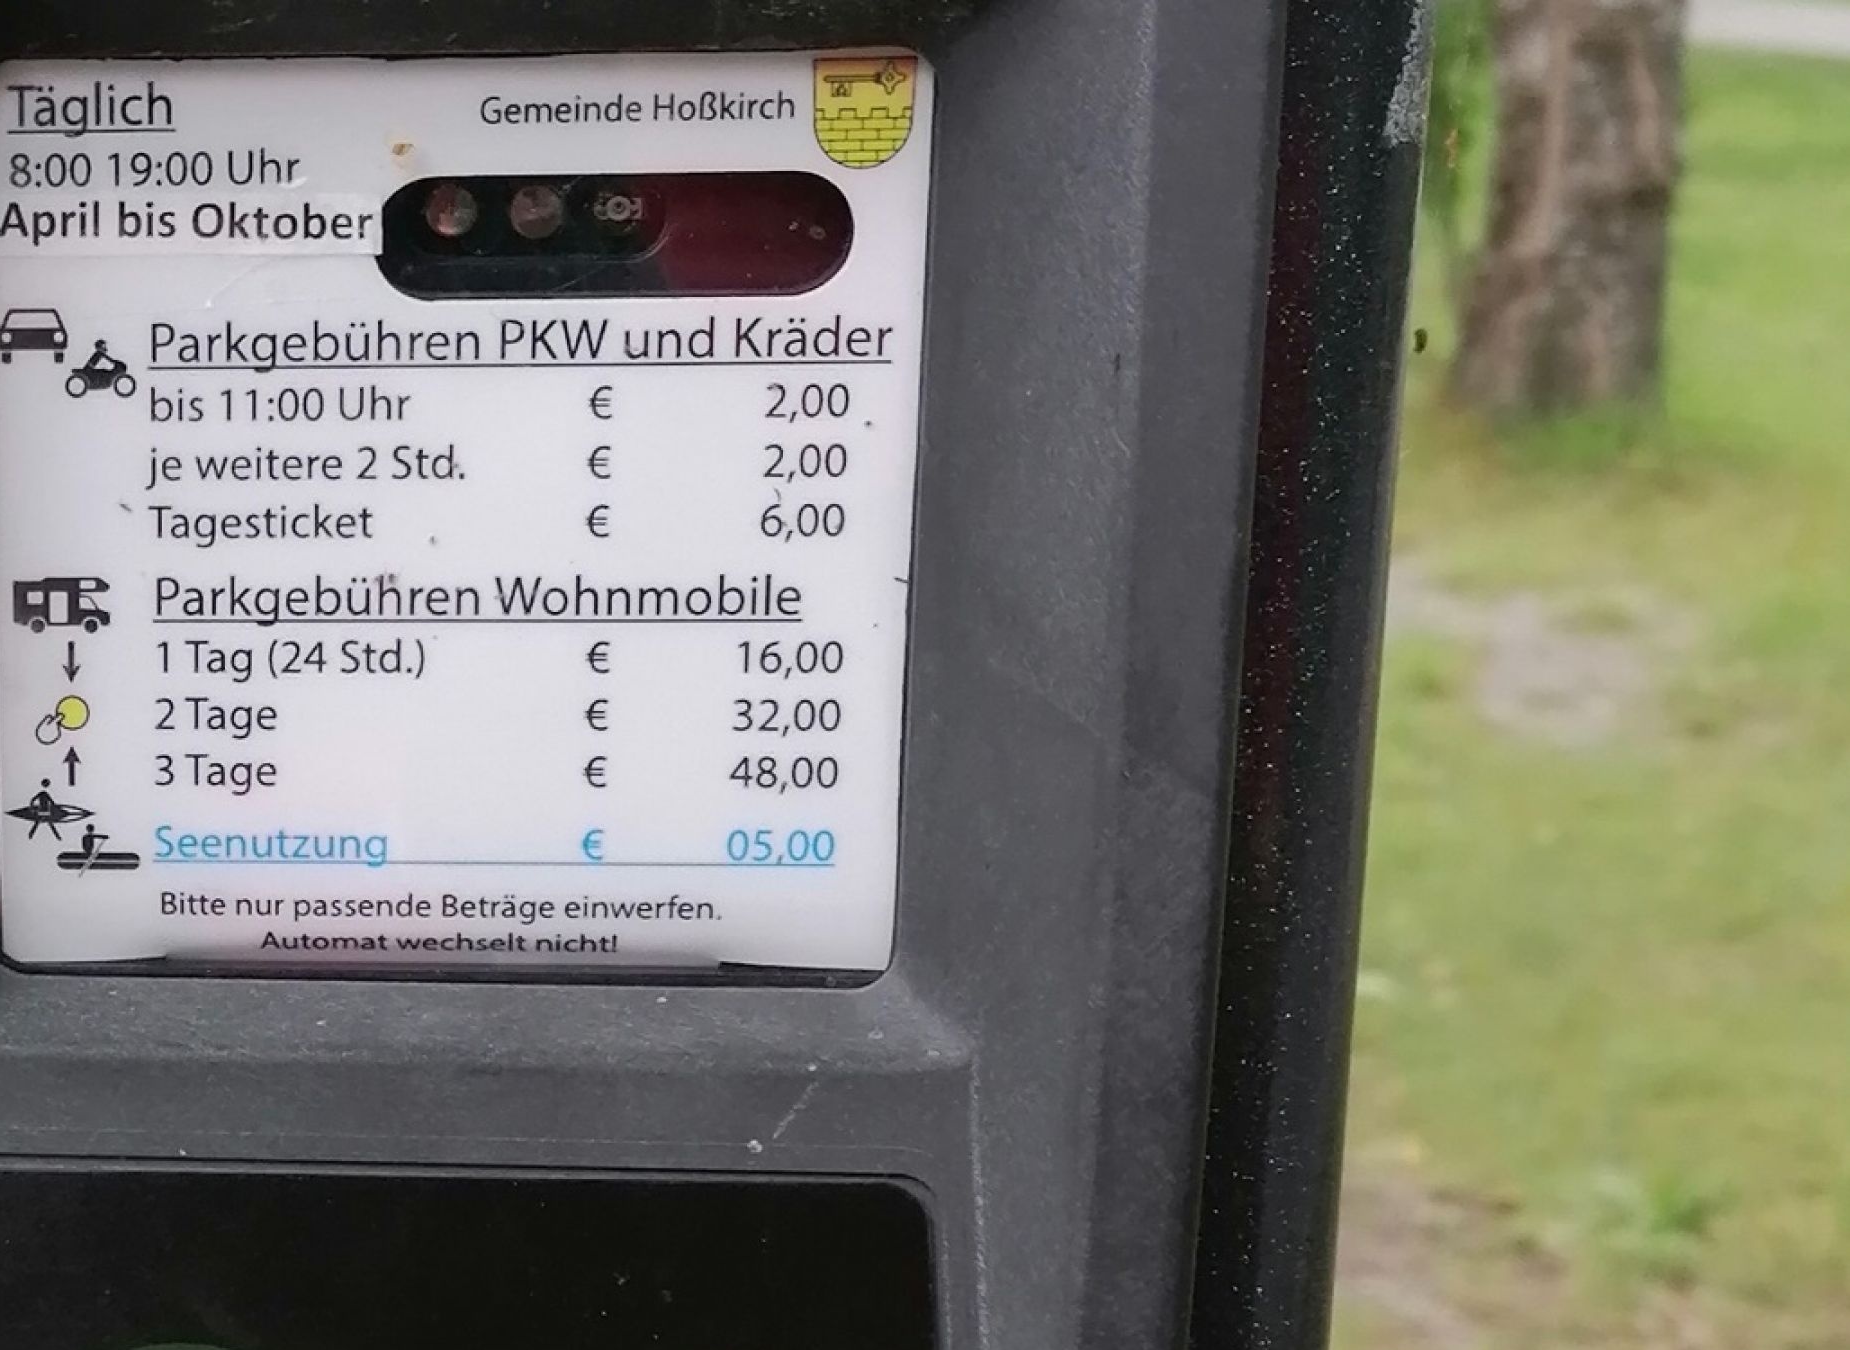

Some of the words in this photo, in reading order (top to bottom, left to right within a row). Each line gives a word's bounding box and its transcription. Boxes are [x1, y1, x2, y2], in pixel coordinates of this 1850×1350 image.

[7, 81, 174, 138] Täglich
[480, 93, 642, 126] Gemeinde
[652, 90, 796, 123] Hoßkirch
[9, 152, 93, 189] 8:00
[107, 150, 214, 188] 19:00
[227, 147, 301, 186] Uhr
[118, 200, 177, 239] bis
[190, 200, 374, 240] Oktober
[151, 319, 481, 371] Parkgebühren
[499, 318, 610, 359] PKW
[623, 315, 717, 358] und
[734, 314, 894, 358] Kräder
[150, 387, 205, 423] bis
[220, 386, 325, 422] 11:00
[339, 384, 412, 422] Uhr
[588, 385, 614, 421] €
[764, 382, 851, 424] 2,00
[145, 447, 183, 488] je
[195, 446, 343, 482] weitere
[356, 445, 378, 480] 2
[391, 443, 467, 480] Std.
[586, 445, 613, 480] €
[762, 442, 848, 484] 2,00
[150, 503, 374, 549] Tagesticket
[585, 504, 611, 539] €
[760, 503, 846, 543] 6,00
[153, 574, 481, 626] Parkgebühren
[493, 574, 803, 619] Wohnmobile
[156, 641, 170, 674] 1
[184, 640, 254, 684] Tag
[267, 638, 327, 682] (24
[339, 636, 427, 682] Std.)
[585, 641, 611, 675] €
[737, 640, 844, 680] 16,00
[154, 697, 176, 730] 2
[184, 697, 278, 740] Tage
[584, 698, 610, 732] €
[731, 698, 842, 738] 32,00
[154, 754, 176, 787] 3
[184, 753, 278, 797] Tage
[582, 755, 608, 789] €
[728, 755, 839, 795] 48,00
[153, 825, 389, 867] Seenutzung
[582, 829, 605, 862] €
[726, 829, 836, 867] 05,00
[160, 890, 226, 917] Bitte
[235, 896, 285, 918] nur
[293, 892, 432, 922] passende
[441, 893, 556, 925] Beträge
[564, 894, 723, 921] einwerfen.
[260, 931, 388, 951] Automat
[396, 932, 526, 952] wechselt
[535, 933, 619, 953] nicht!
